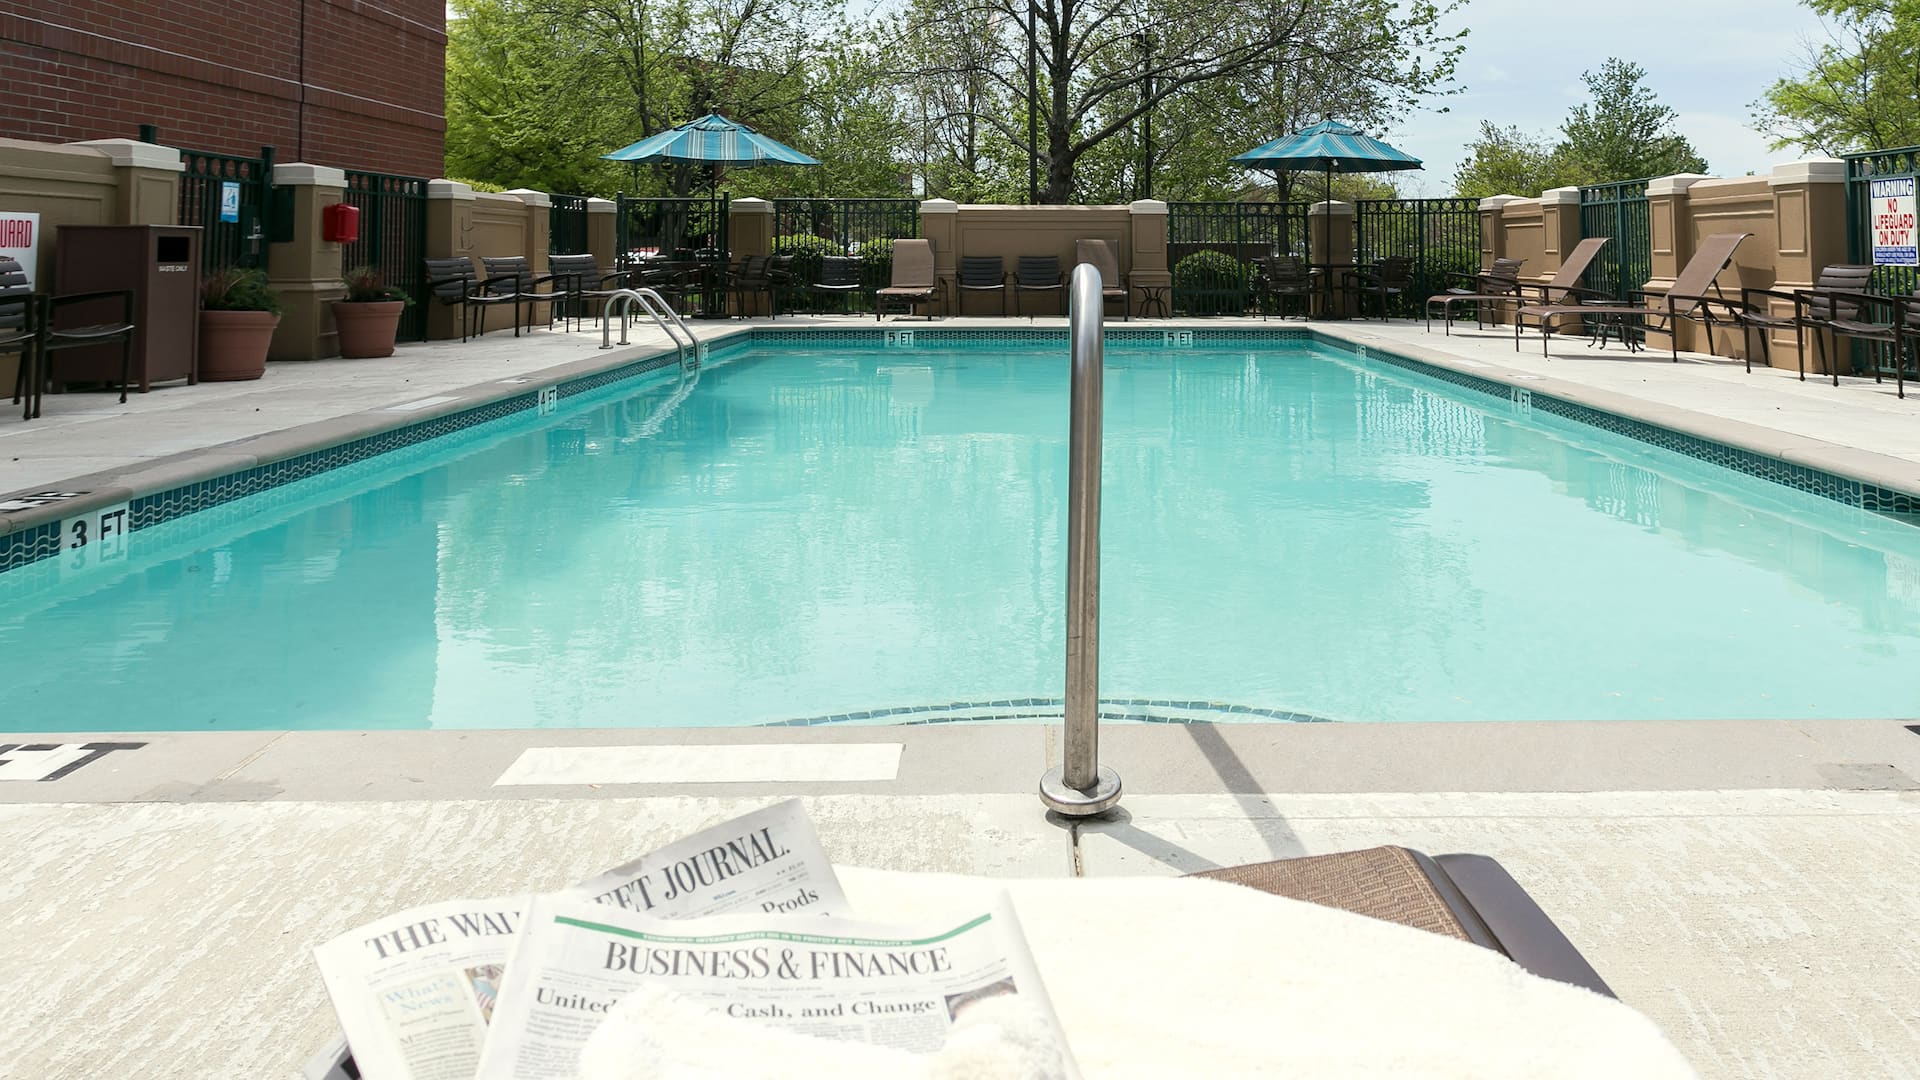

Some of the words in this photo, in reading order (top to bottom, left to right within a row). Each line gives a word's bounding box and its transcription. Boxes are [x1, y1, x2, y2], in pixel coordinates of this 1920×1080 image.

[1873, 179, 1913, 197] WARNING
[1887, 198, 1898, 213] NO
[1874, 214, 1914, 229] LIFEGUARD
[1879, 231, 1889, 245] ON
[1891, 230, 1909, 245] DUTY
[71, 519, 88, 549] 3
[101, 509, 126, 541] FT
[661, 827, 791, 900] JOURNAL.
[761, 888, 820, 914] Prods
[364, 918, 447, 959] THE
[446, 911, 521, 937] WAL
[604, 941, 770, 980] BUSINESS
[777, 947, 802, 980] &
[809, 947, 952, 980] FINANCE
[727, 1002, 793, 1018] Cash,
[800, 1002, 844, 1017] and
[852, 1000, 936, 1015] Change
